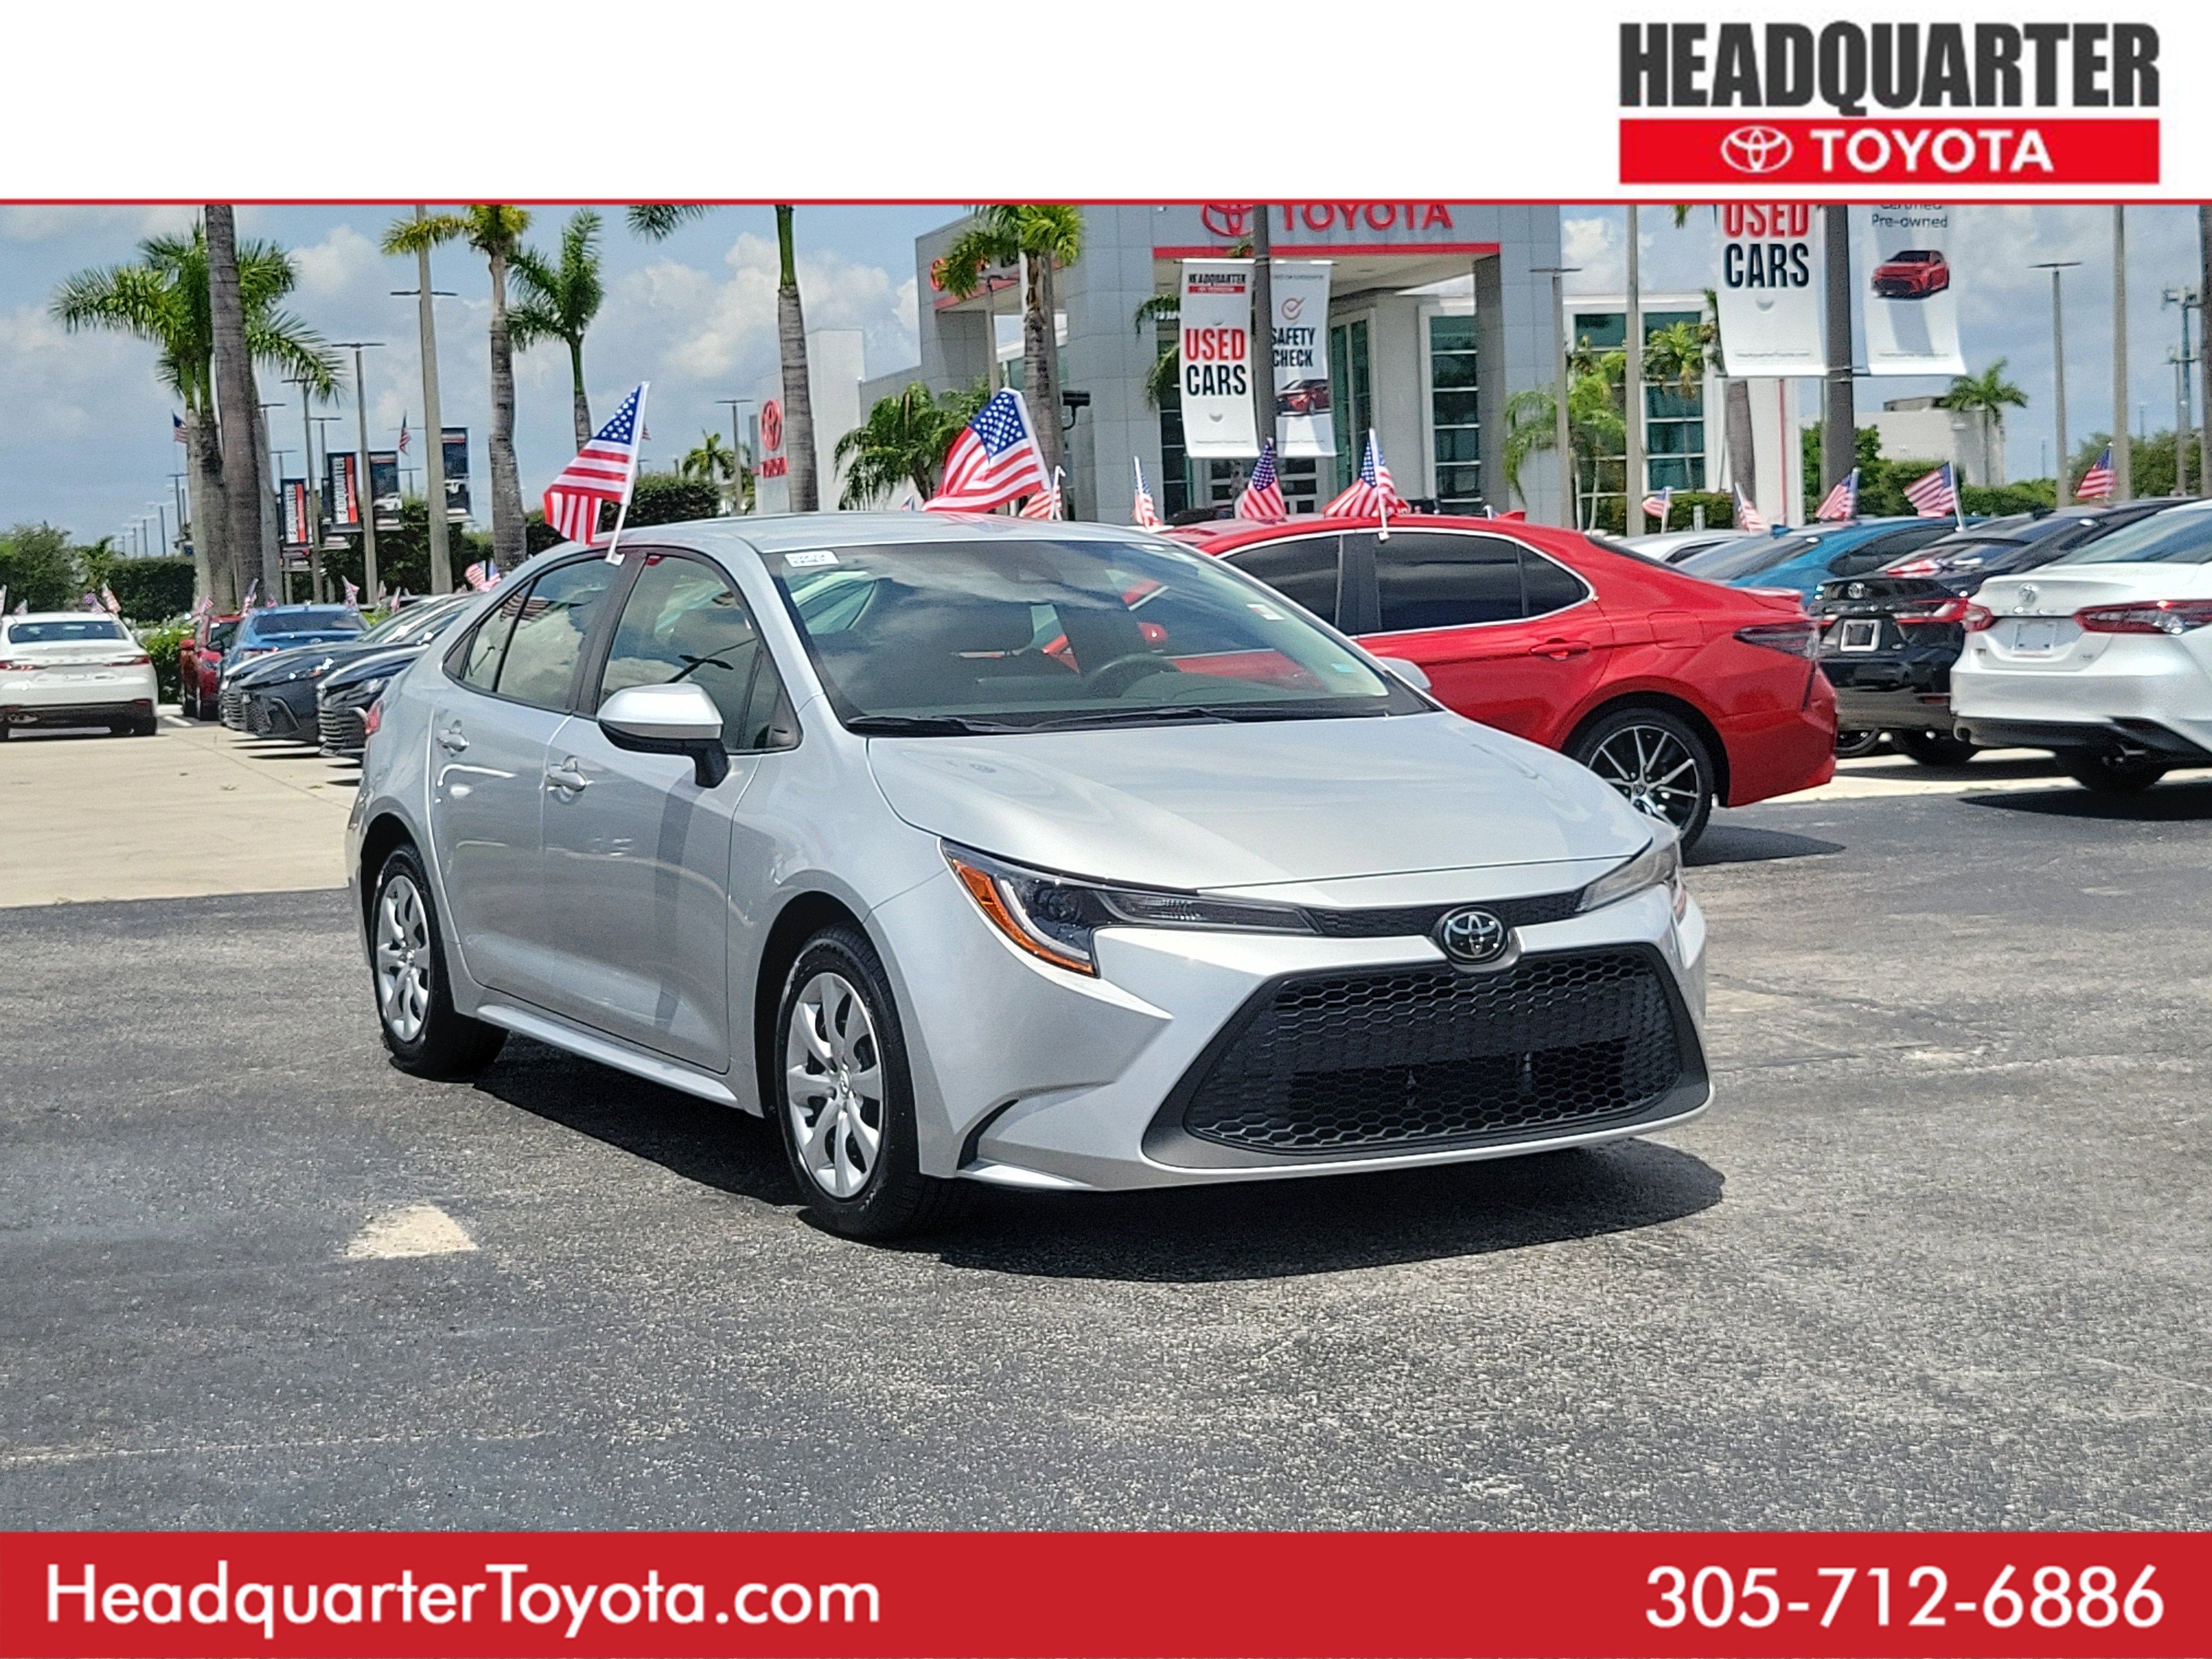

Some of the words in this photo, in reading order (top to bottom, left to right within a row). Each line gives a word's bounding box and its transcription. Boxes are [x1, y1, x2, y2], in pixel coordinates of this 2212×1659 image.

[1283, 205, 1453, 231] TOYOTA
[1723, 205, 1810, 238] USED
[1871, 213, 1948, 228] Pre-owned
[1724, 242, 1809, 288] CARS
[1184, 329, 1245, 362] USED
[1272, 327, 1316, 346] SAFETY
[1273, 349, 1313, 367] CHECK
[1186, 364, 1246, 396] CARS
